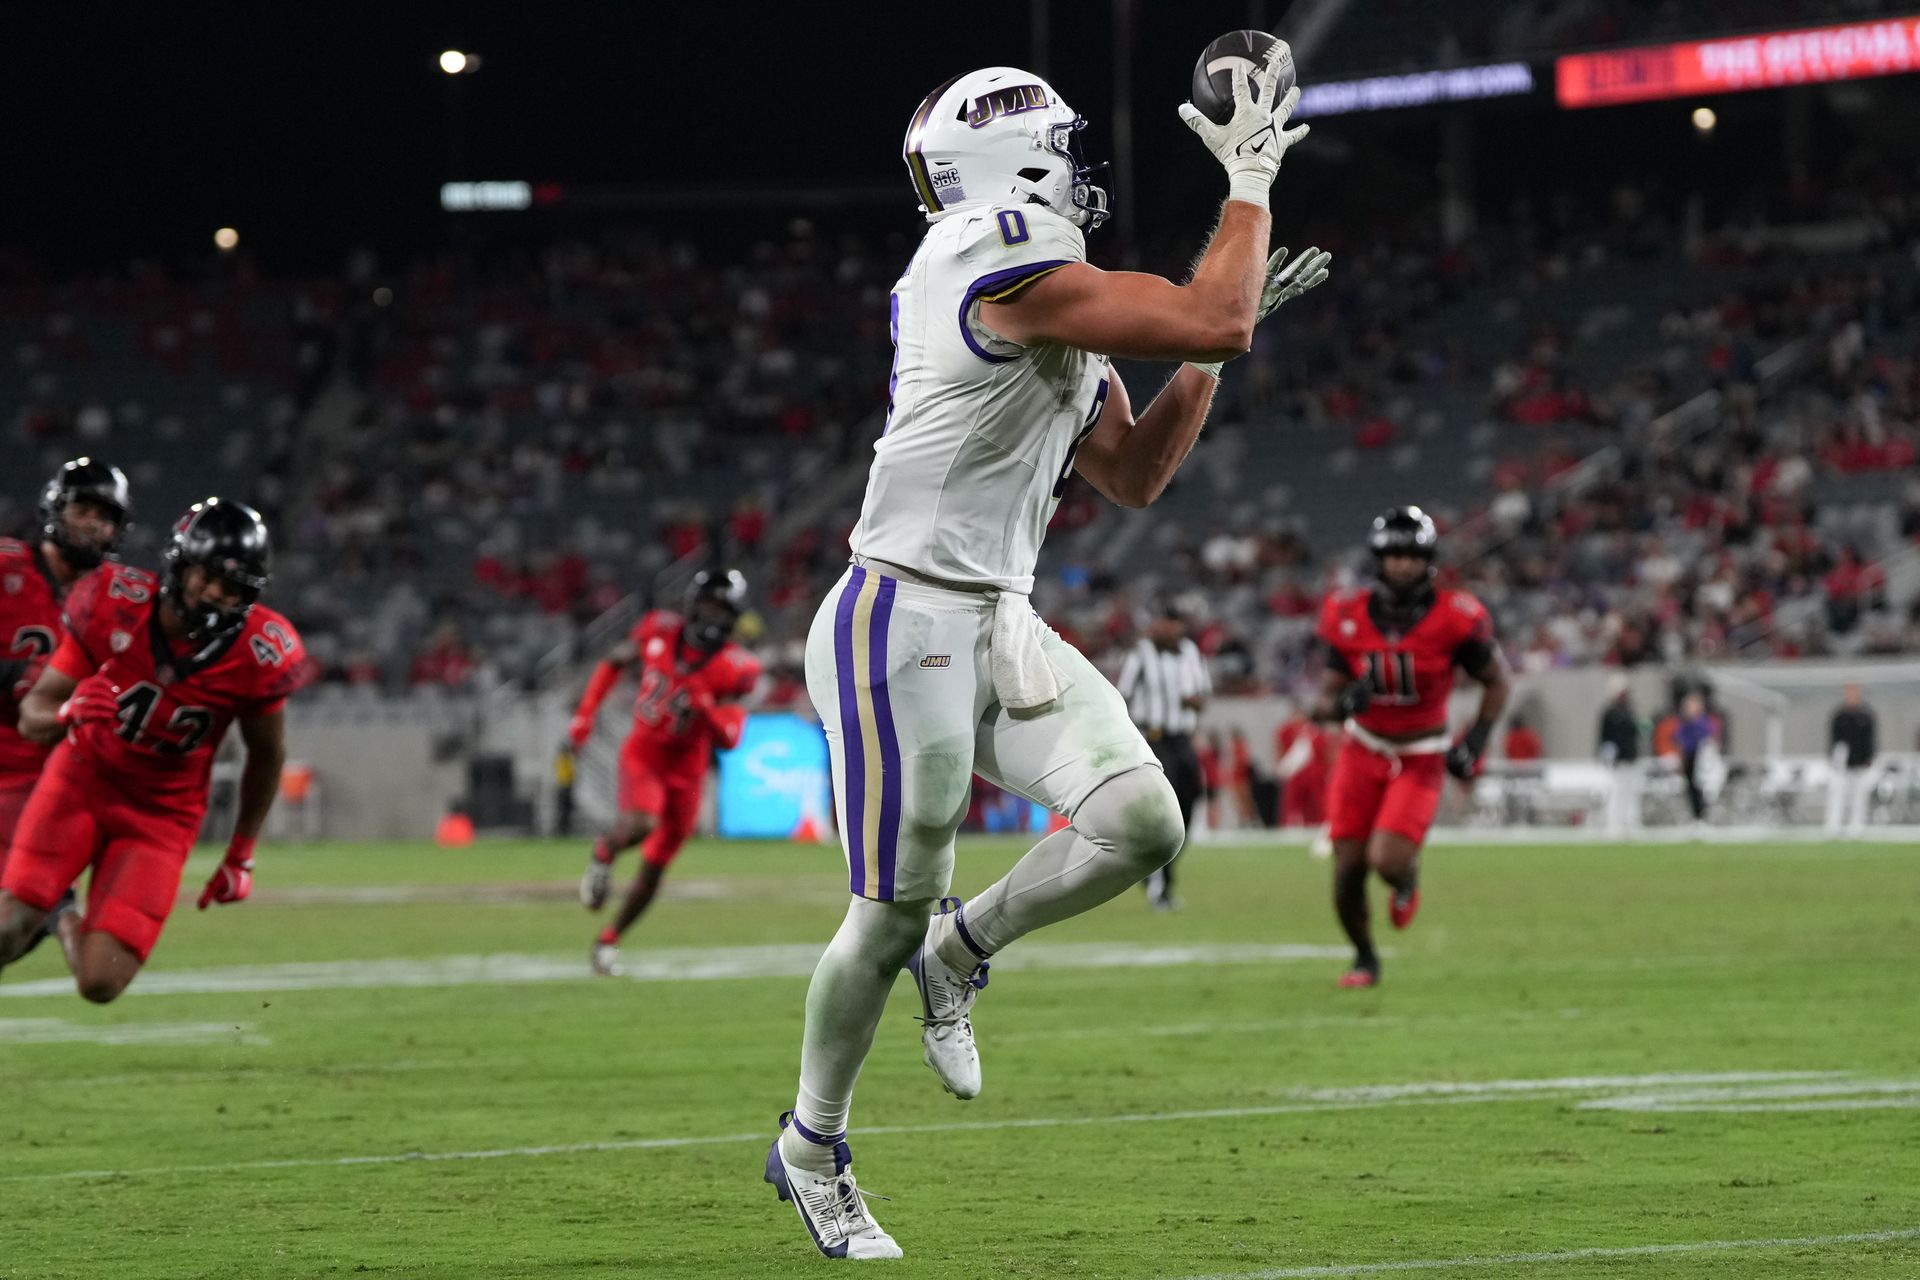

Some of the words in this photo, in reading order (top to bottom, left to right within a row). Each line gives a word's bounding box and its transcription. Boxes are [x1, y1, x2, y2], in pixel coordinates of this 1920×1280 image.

[967, 85, 1049, 129] JMU
[931, 168, 960, 188] SBC
[995, 209, 1032, 248] 0
[249, 620, 296, 667] 42
[919, 653, 952, 669] JMU
